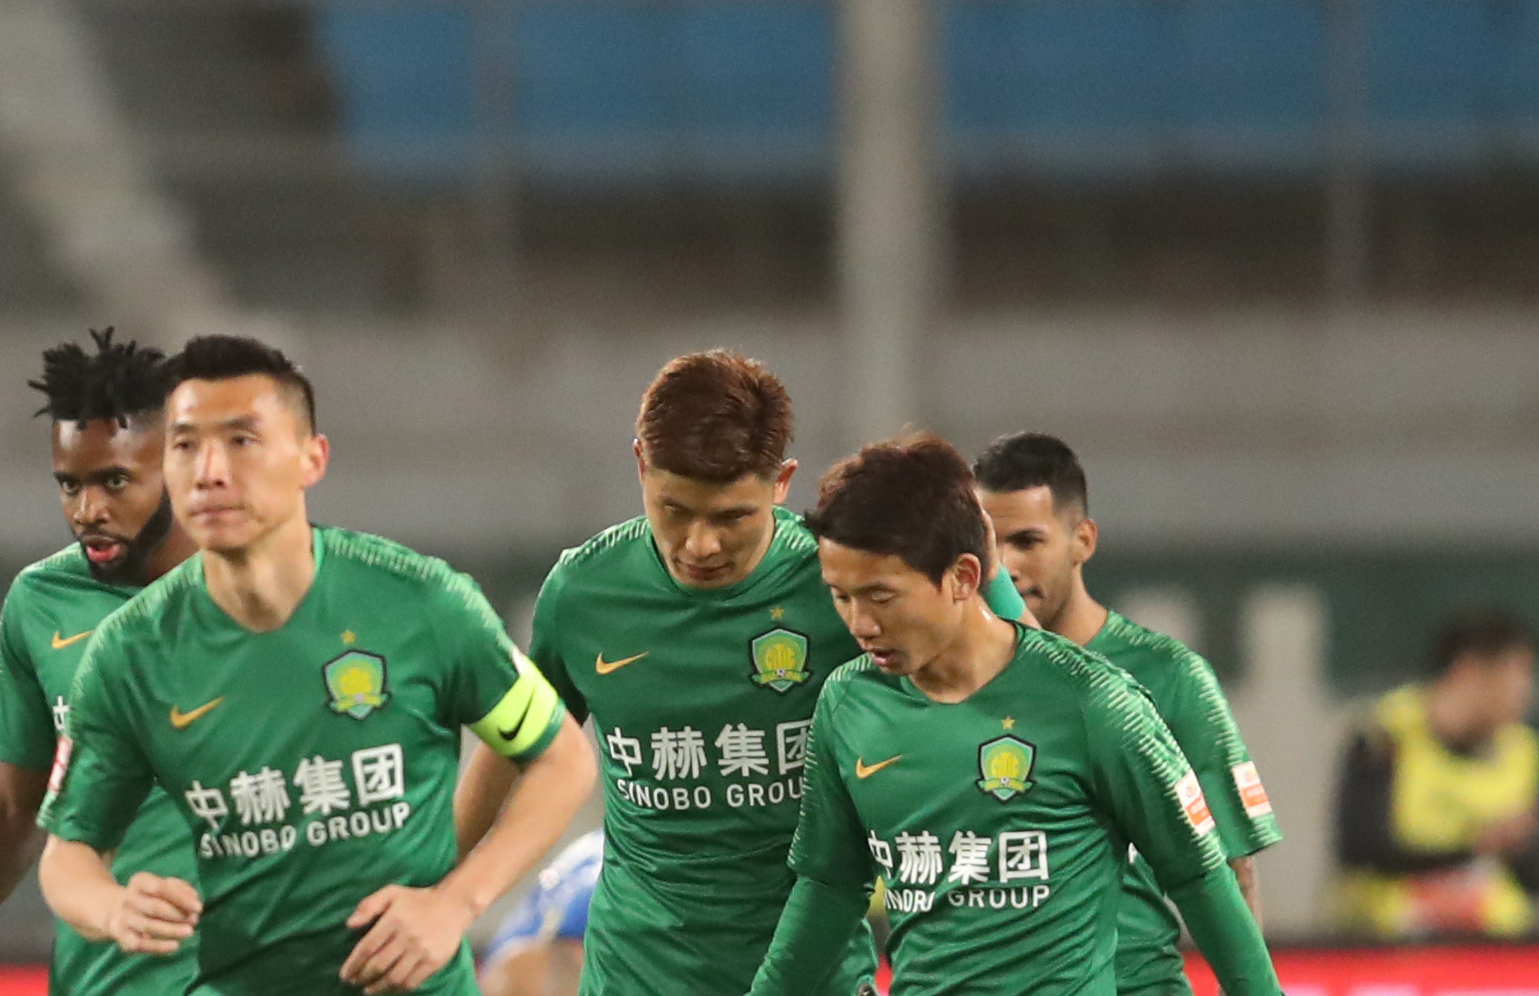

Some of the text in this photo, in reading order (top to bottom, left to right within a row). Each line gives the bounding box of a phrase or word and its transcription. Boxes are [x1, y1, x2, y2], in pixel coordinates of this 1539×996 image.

[606, 719, 811, 780] 中赫集团
[185, 743, 405, 829] 中赫集团
[617, 779, 803, 810] SINOBO GROU
[200, 802, 411, 858] SINOBO GROUP
[867, 830, 1049, 885] 中赫集团
[947, 885, 1050, 909] GROUP
